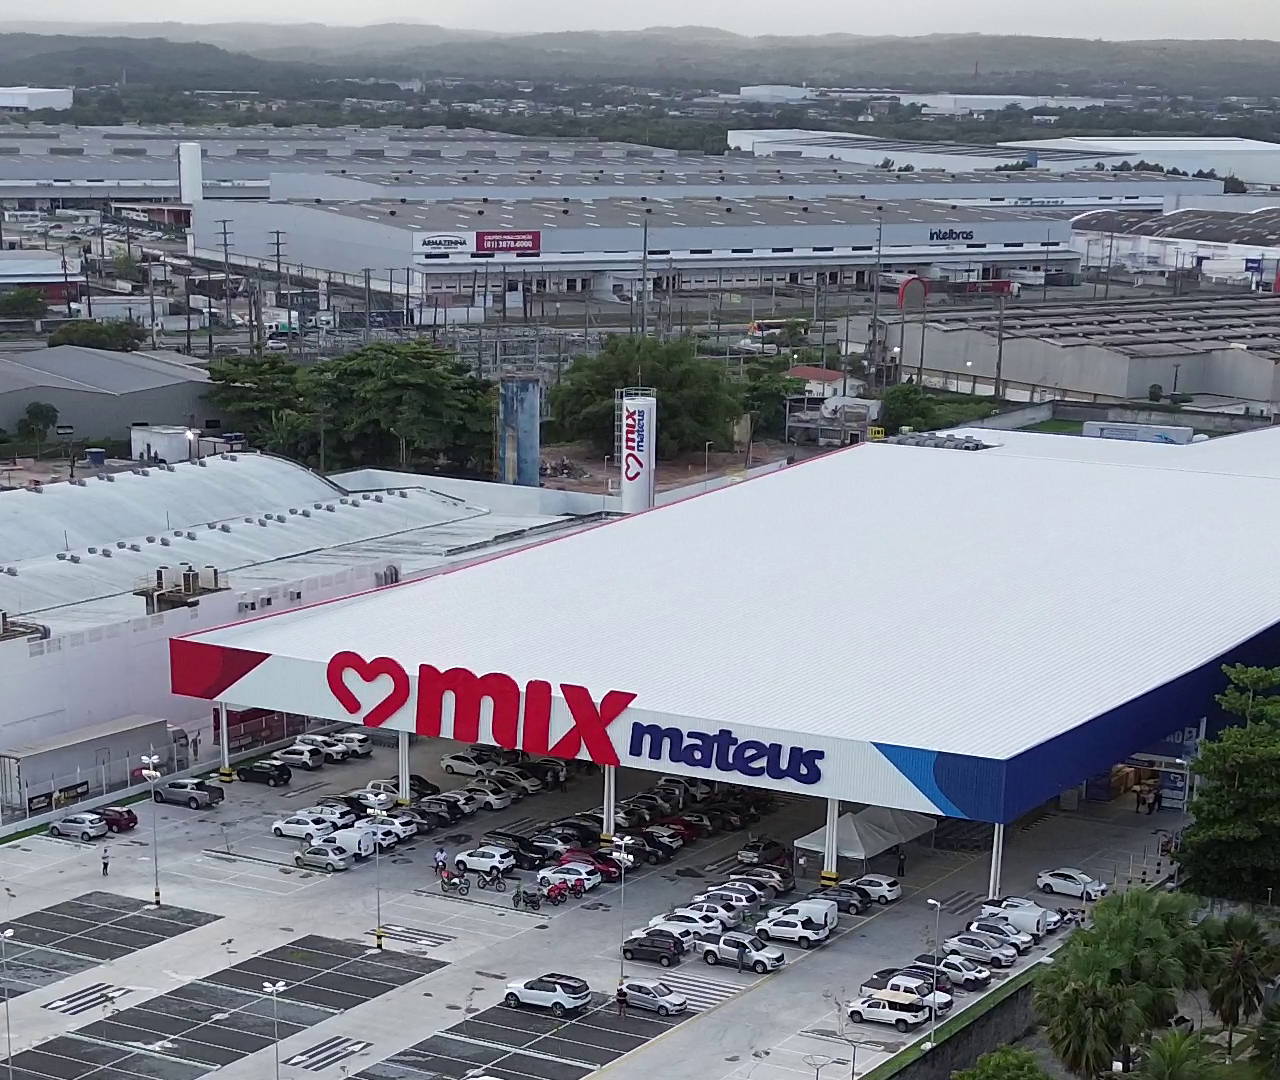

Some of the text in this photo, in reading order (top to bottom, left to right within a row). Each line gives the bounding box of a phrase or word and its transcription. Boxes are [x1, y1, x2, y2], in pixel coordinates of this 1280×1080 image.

[929, 229, 974, 241] intelbras
[636, 409, 645, 453] mateus
[628, 721, 825, 785] mateus
